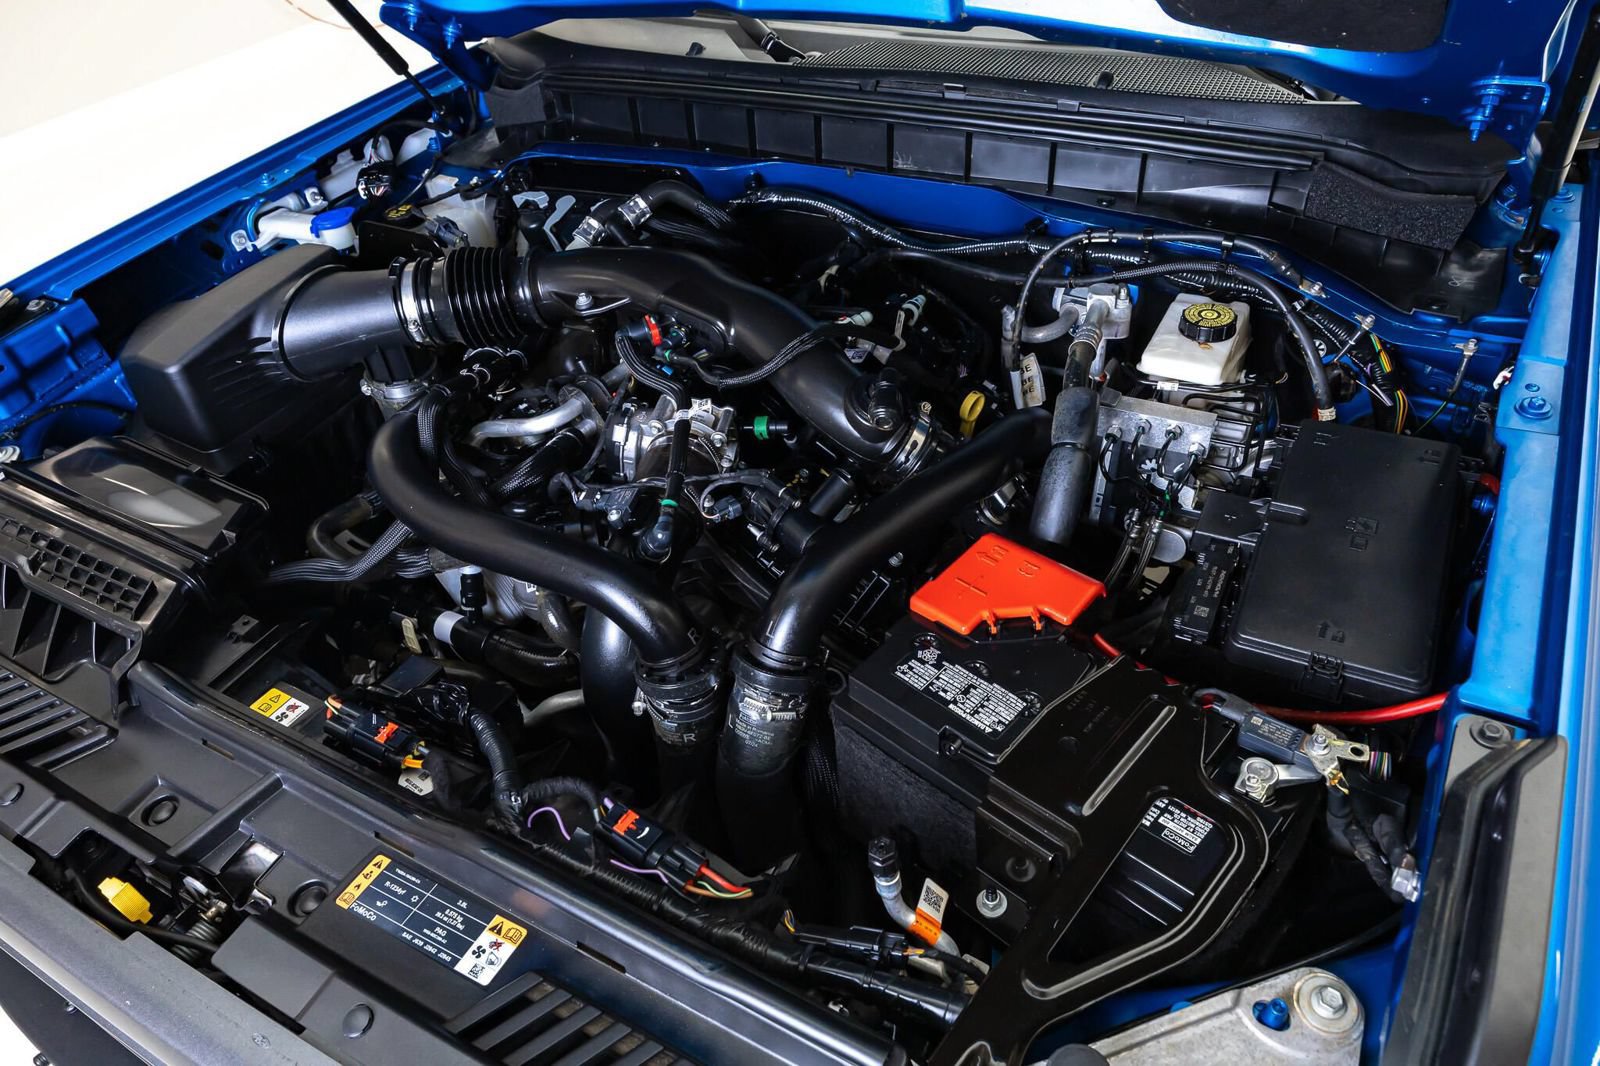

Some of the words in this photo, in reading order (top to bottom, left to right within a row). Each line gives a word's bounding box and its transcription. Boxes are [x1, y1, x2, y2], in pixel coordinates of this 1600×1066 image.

[688, 628, 700, 644] R
[683, 733, 696, 743] R
[1164, 830, 1194, 850] FoMoCo
[384, 880, 407, 895] R-1234yf
[350, 903, 378, 921] FoMoCo
[434, 926, 447, 937] PAG
